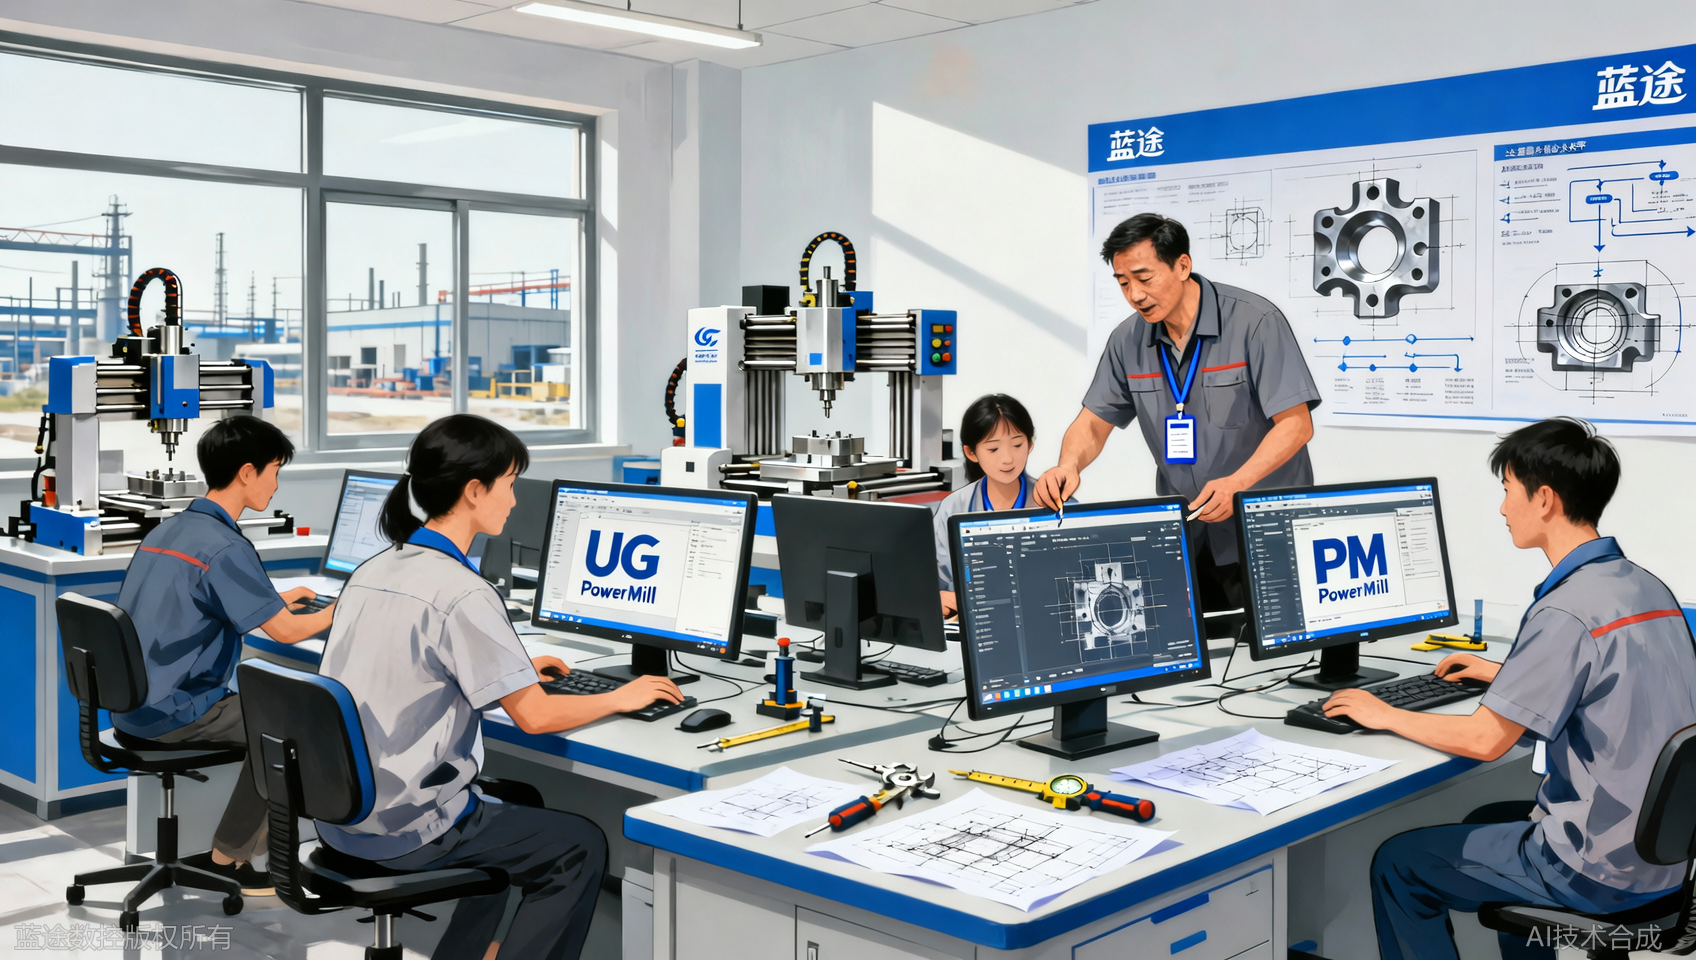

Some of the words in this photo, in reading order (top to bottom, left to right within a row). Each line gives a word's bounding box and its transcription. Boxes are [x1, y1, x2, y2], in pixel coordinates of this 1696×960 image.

[1592, 60, 1687, 110] 蓝途
[1106, 126, 1165, 162] 蓝途
[585, 529, 660, 579] UG
[1312, 533, 1388, 584] PM
